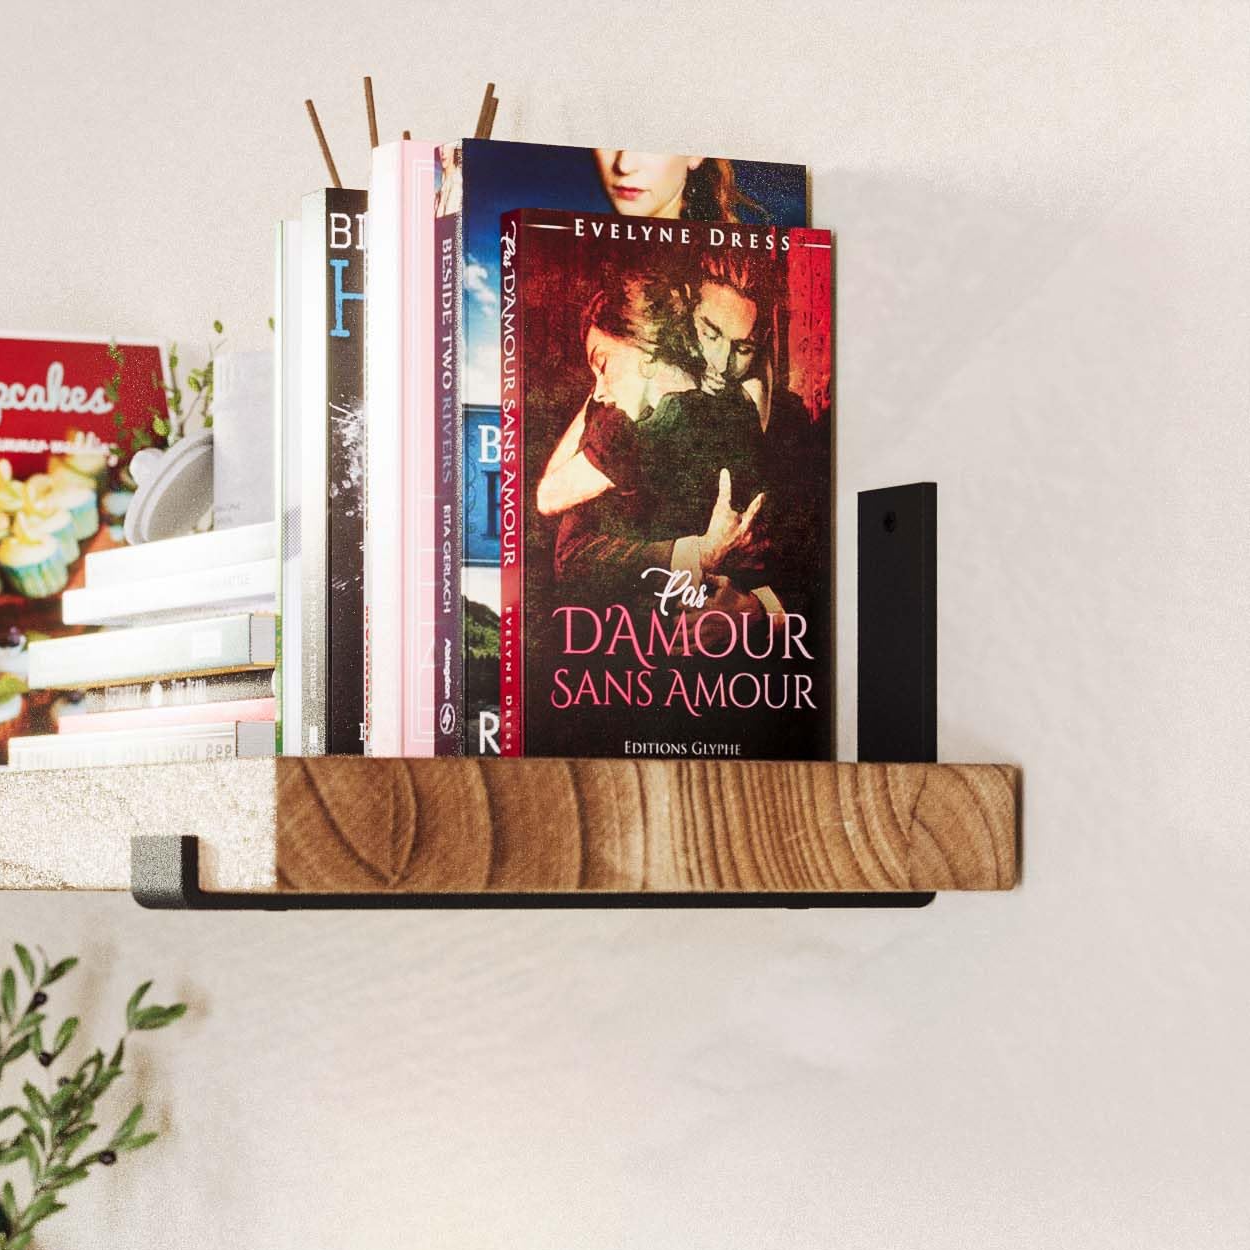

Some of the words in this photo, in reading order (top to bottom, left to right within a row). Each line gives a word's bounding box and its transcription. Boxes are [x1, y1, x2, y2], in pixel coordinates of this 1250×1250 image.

[500, 220, 515, 268] Pas
[574, 218, 691, 244] EVELYNE
[710, 228, 791, 251] DRESS
[441, 238, 452, 325] BESIDE
[441, 328, 452, 389] TWO
[500, 269, 516, 392] D'AMOUR
[441, 394, 452, 483] RIVERS
[503, 399, 515, 462] SANS
[442, 504, 452, 537] RITA
[501, 470, 515, 566] AMOUR
[442, 540, 452, 613] GERLACH
[641, 567, 708, 616] Pas
[551, 604, 815, 670] D'AMOUR
[504, 695, 512, 749] DRESS
[551, 669, 655, 709] SANS
[663, 669, 818, 717] AMOUR
[624, 740, 688, 755] EDITIONS
[692, 741, 742, 756] GLYPHE
